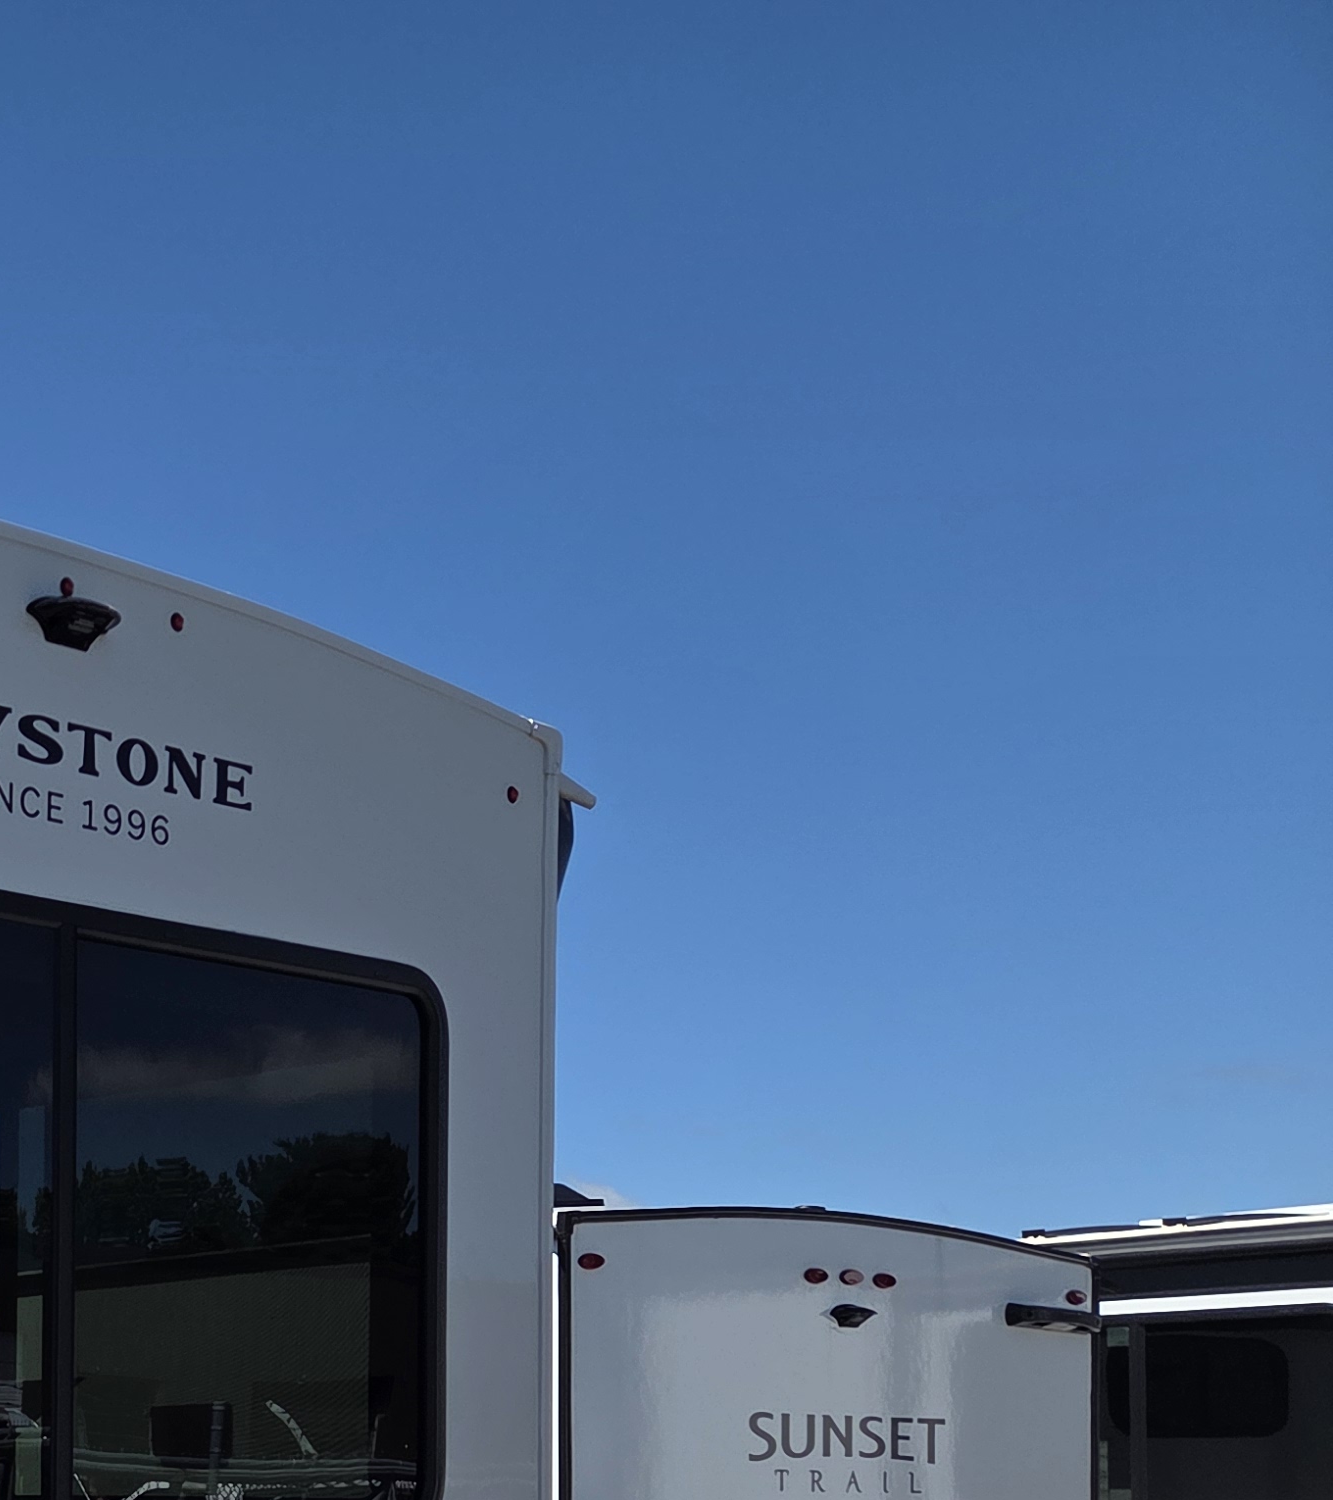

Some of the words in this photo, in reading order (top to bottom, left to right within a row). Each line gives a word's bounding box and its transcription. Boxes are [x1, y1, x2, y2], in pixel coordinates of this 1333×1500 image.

[80, 799, 171, 847] 1996
[748, 1411, 947, 1465] SUNSET
[773, 1468, 924, 1494] TRAIL
